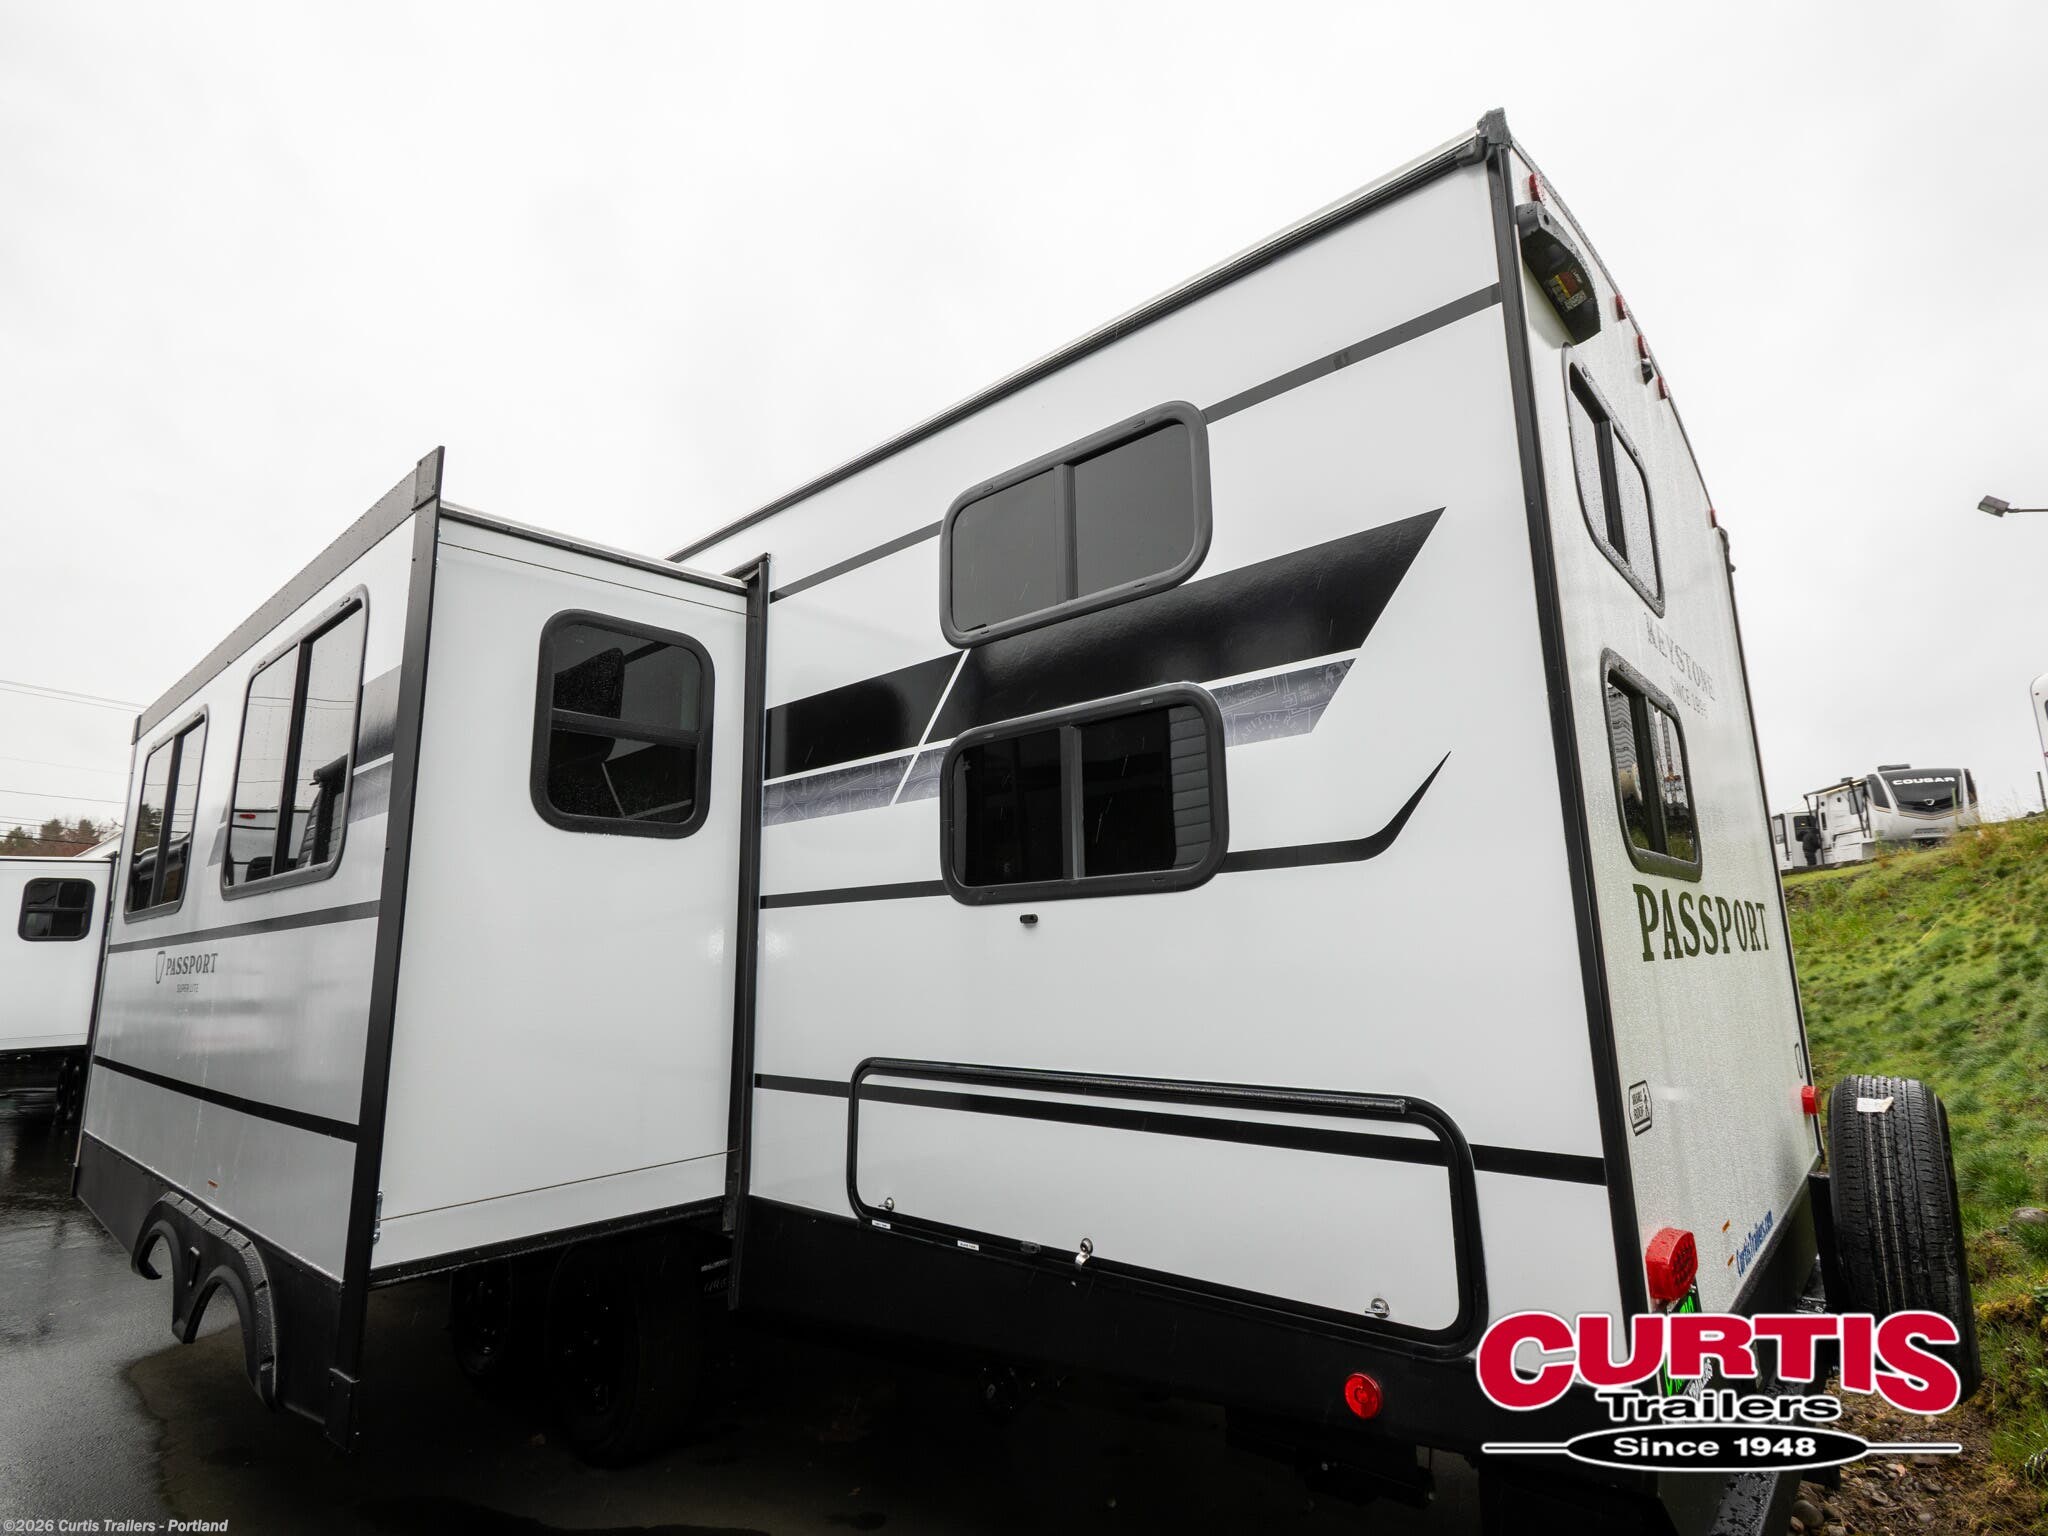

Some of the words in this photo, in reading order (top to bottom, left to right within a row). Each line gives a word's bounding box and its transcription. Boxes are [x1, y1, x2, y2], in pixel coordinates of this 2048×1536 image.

[1892, 776, 1956, 786] COUGAR
[1633, 883, 1769, 962] PASSPORT
[165, 953, 218, 976] PASSPORT
